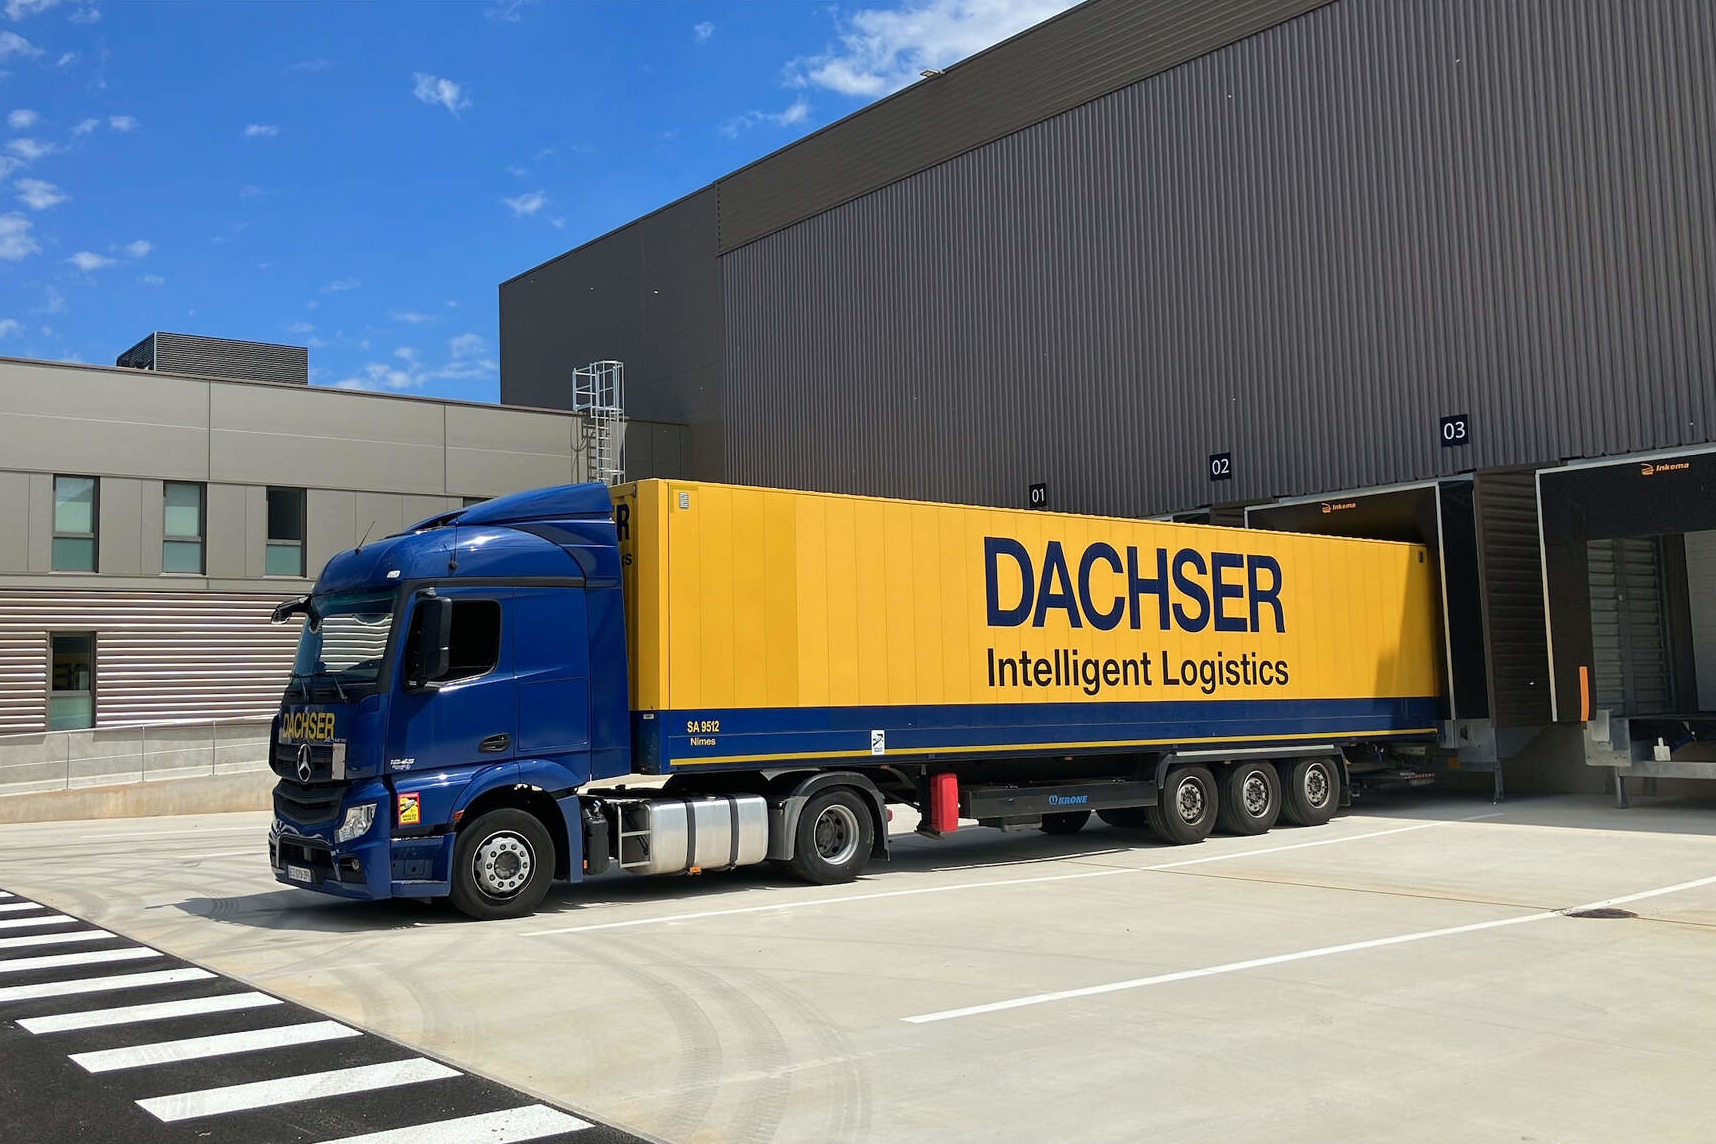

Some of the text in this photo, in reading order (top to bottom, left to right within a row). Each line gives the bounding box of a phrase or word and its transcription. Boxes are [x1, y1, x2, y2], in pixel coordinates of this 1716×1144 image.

[1443, 421, 1466, 440] 03
[1212, 458, 1230, 475] 02
[1656, 462, 1690, 472] Inkema
[1032, 488, 1045, 503] 01
[984, 536, 1286, 633] DACHSER
[987, 648, 1289, 696] Intelligent Logistics
[282, 712, 336, 739] DACHSER
[687, 720, 720, 733] SA 9512
[1058, 795, 1088, 805] KRONE
